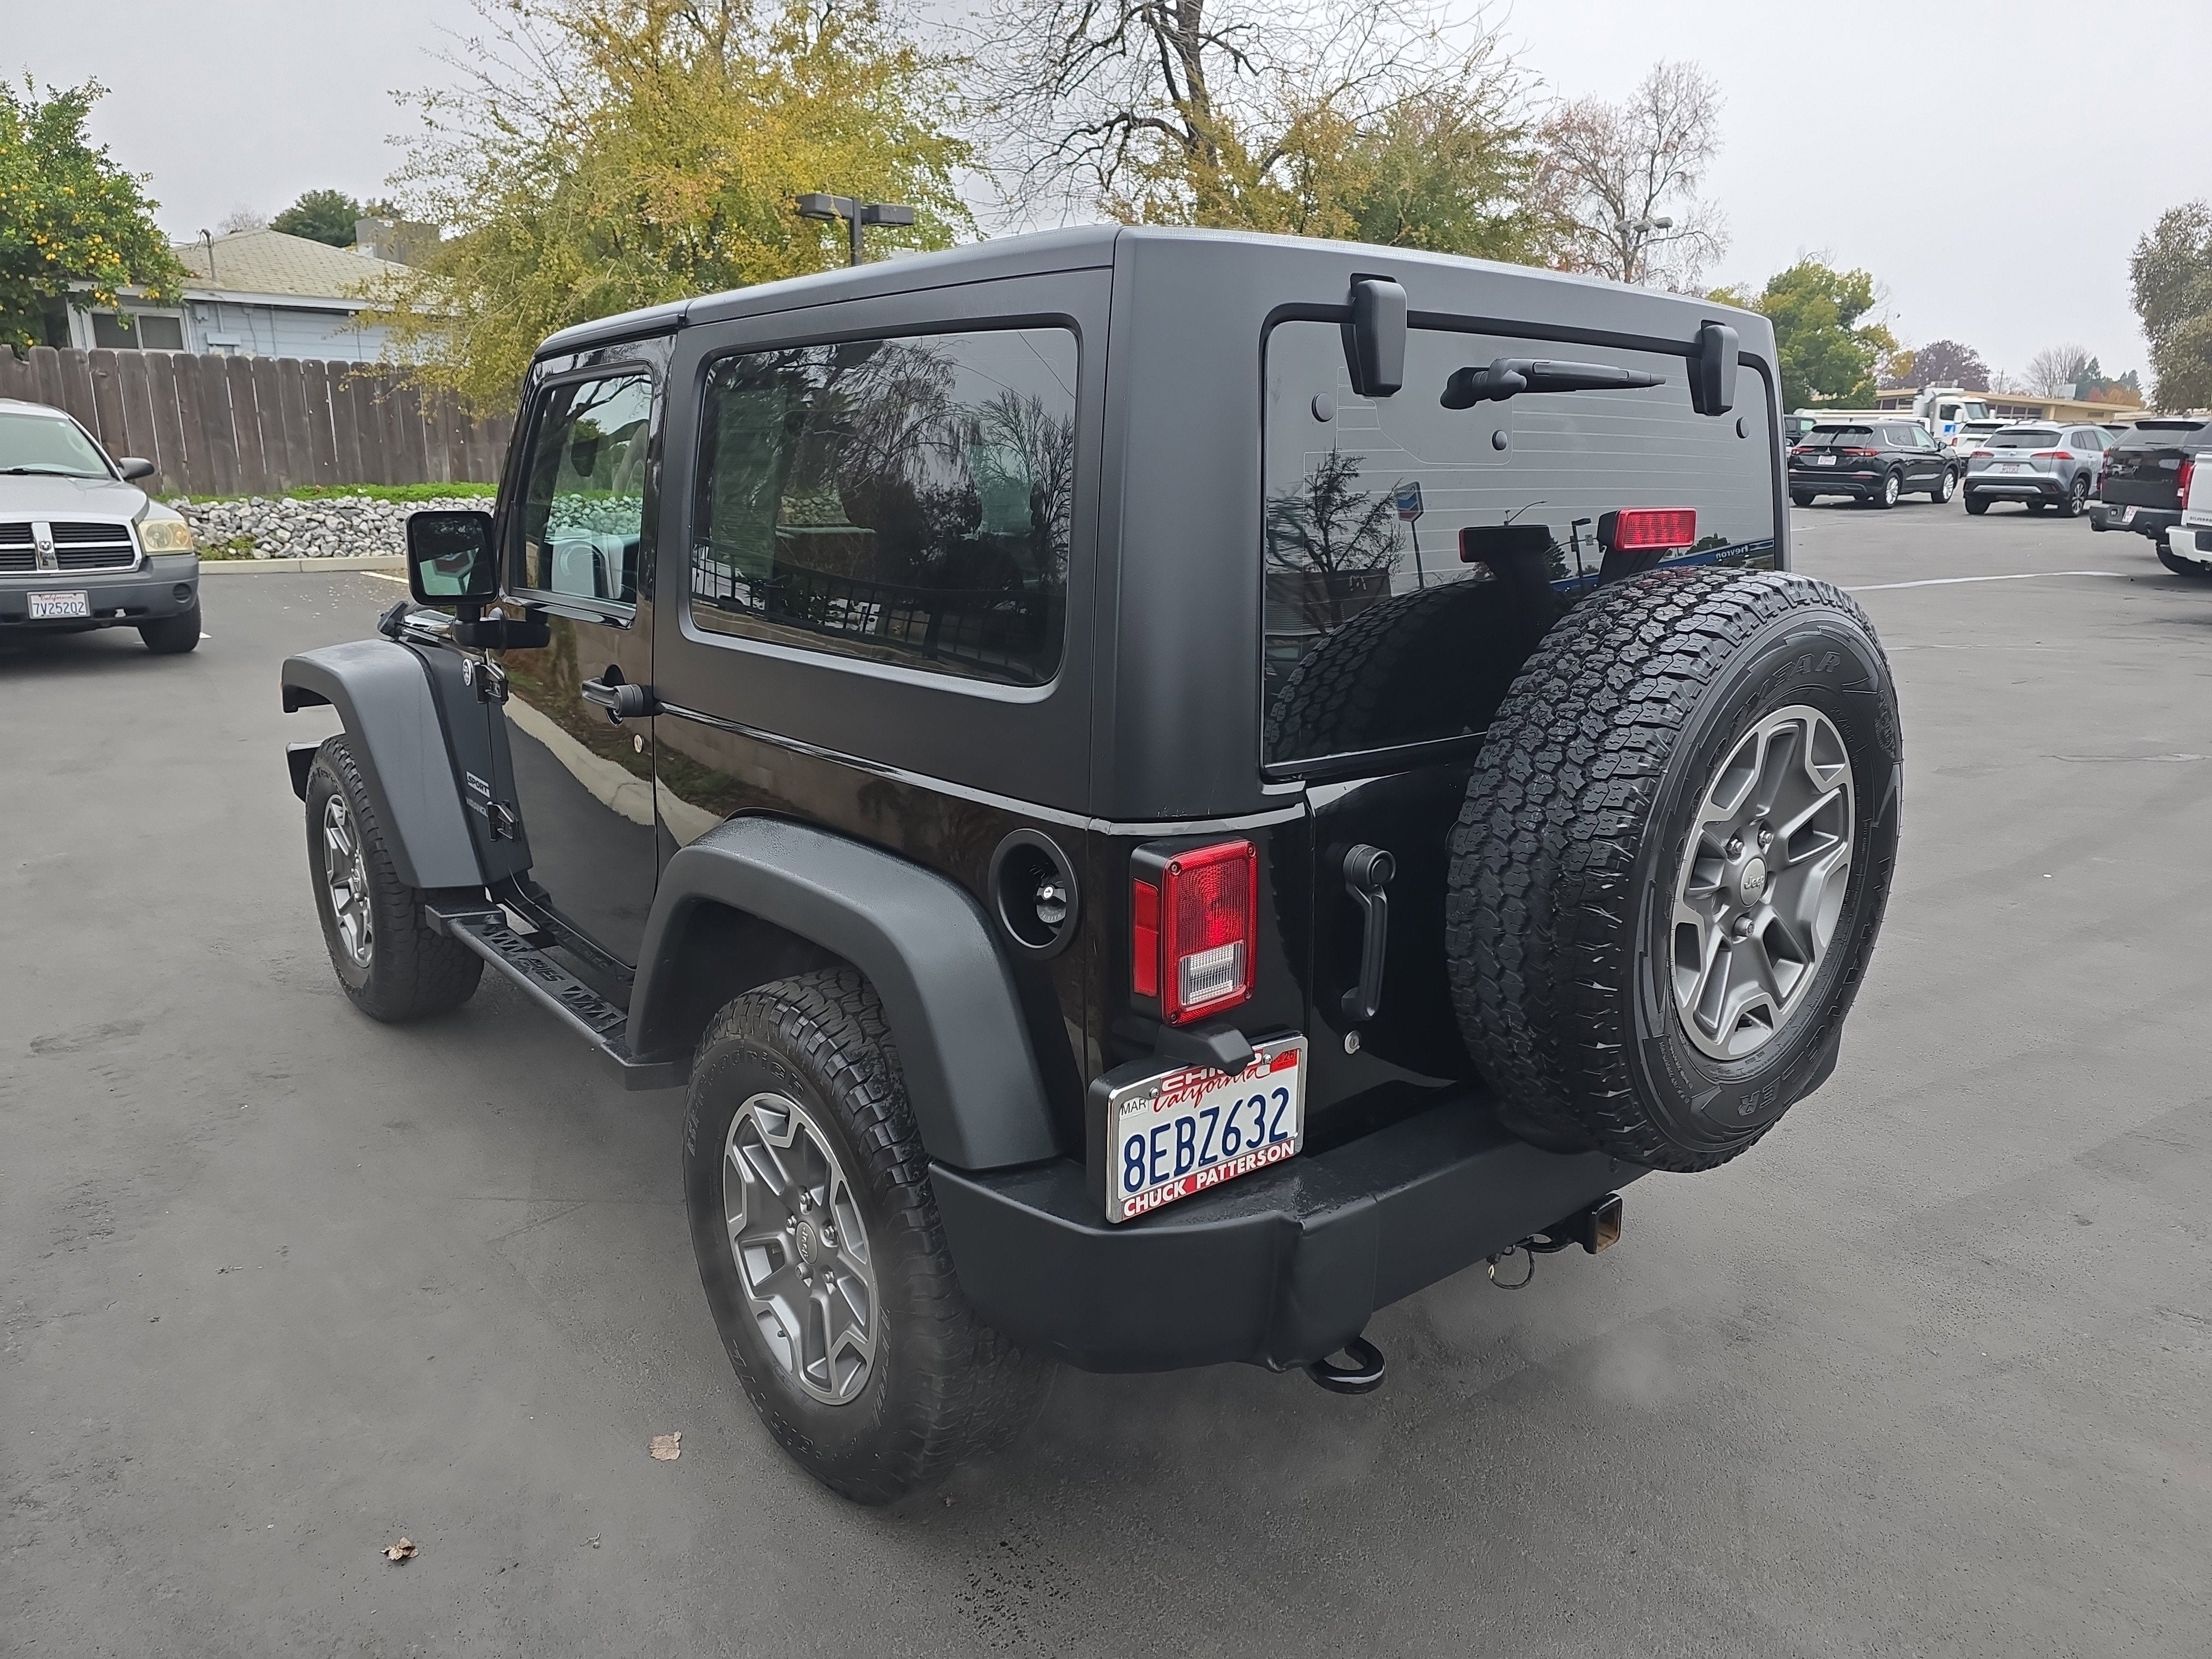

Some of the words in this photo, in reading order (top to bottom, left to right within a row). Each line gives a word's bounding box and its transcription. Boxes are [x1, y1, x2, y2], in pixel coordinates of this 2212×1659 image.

[33, 601, 85, 615] 7V25202
[468, 775, 488, 793] SPORT
[1744, 875, 1764, 890] Jeep
[1284, 1050, 1295, 1061] 26
[1153, 1066, 1270, 1113] California
[1121, 1098, 1147, 1116] MAR
[1124, 1087, 1289, 1193] 8EBZ632
[1124, 1178, 1186, 1217] CHUCK
[1196, 1139, 1295, 1190] PATTERSON
